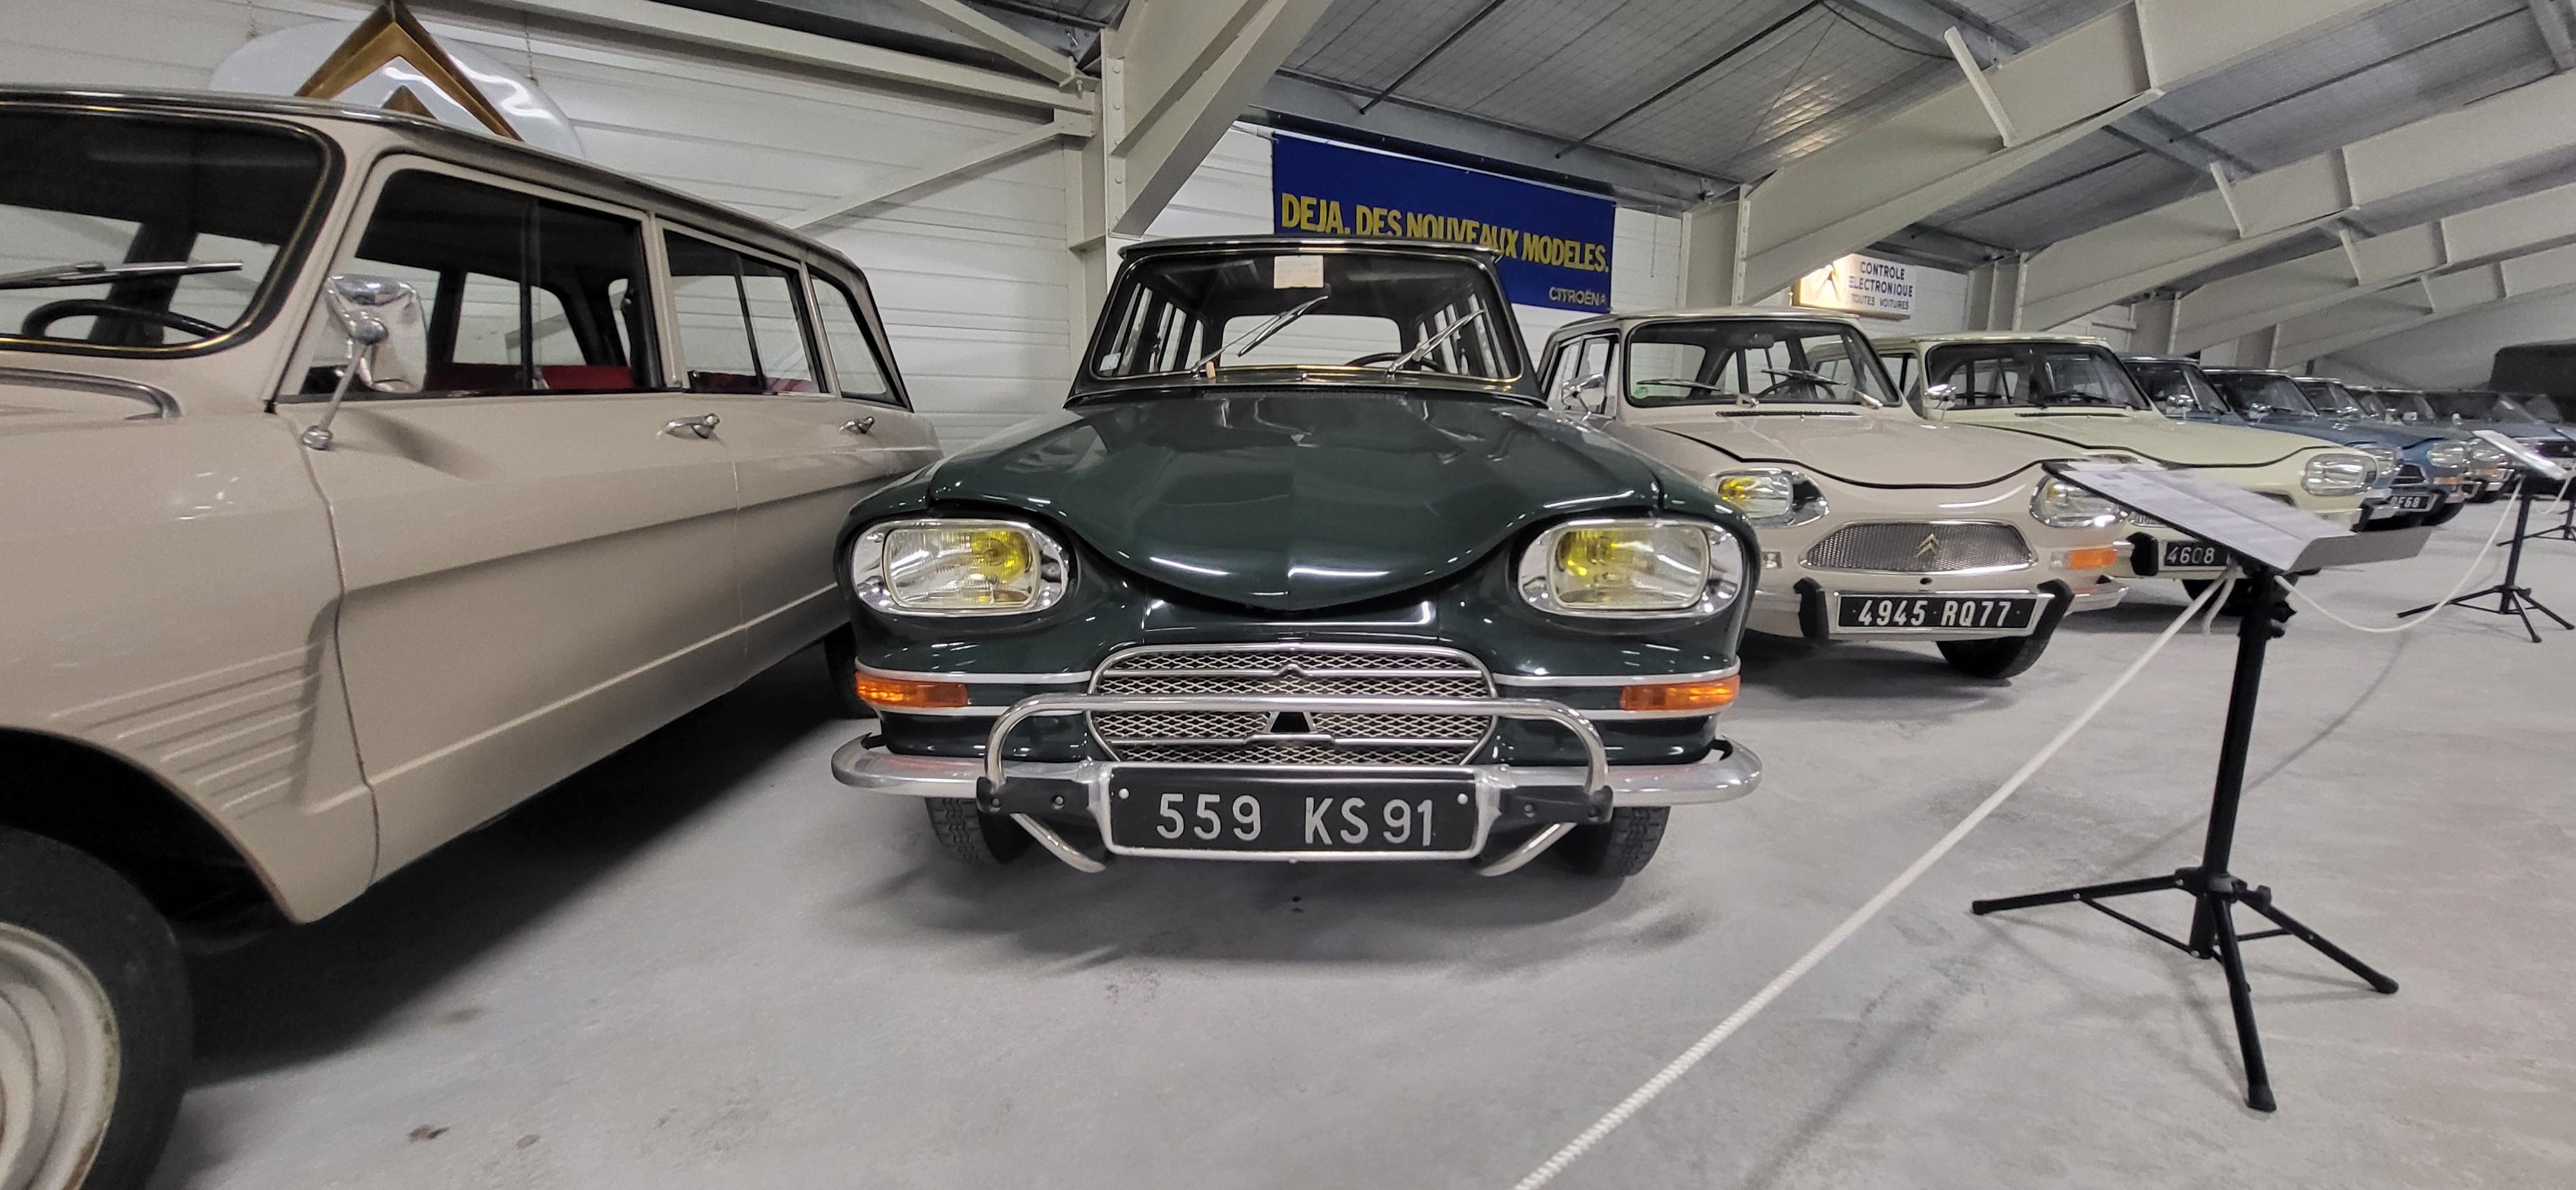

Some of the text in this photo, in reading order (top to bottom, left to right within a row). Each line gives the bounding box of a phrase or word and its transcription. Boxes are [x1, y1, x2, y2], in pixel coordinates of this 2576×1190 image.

[1356, 205, 1403, 236] DES
[1407, 212, 1519, 259] NOUVEAUX
[1521, 232, 1609, 273] MODELES.
[1861, 261, 1905, 280] CONTROLE
[1549, 287, 1600, 306] CITROËN
[1849, 276, 1913, 297] ELECTRONIQUE
[1852, 294, 1909, 310] TOUTES VOITURES
[2167, 546, 2215, 564] 4608
[1858, 600, 2012, 627] 4945 RQ77
[1157, 793, 1262, 840] 559
